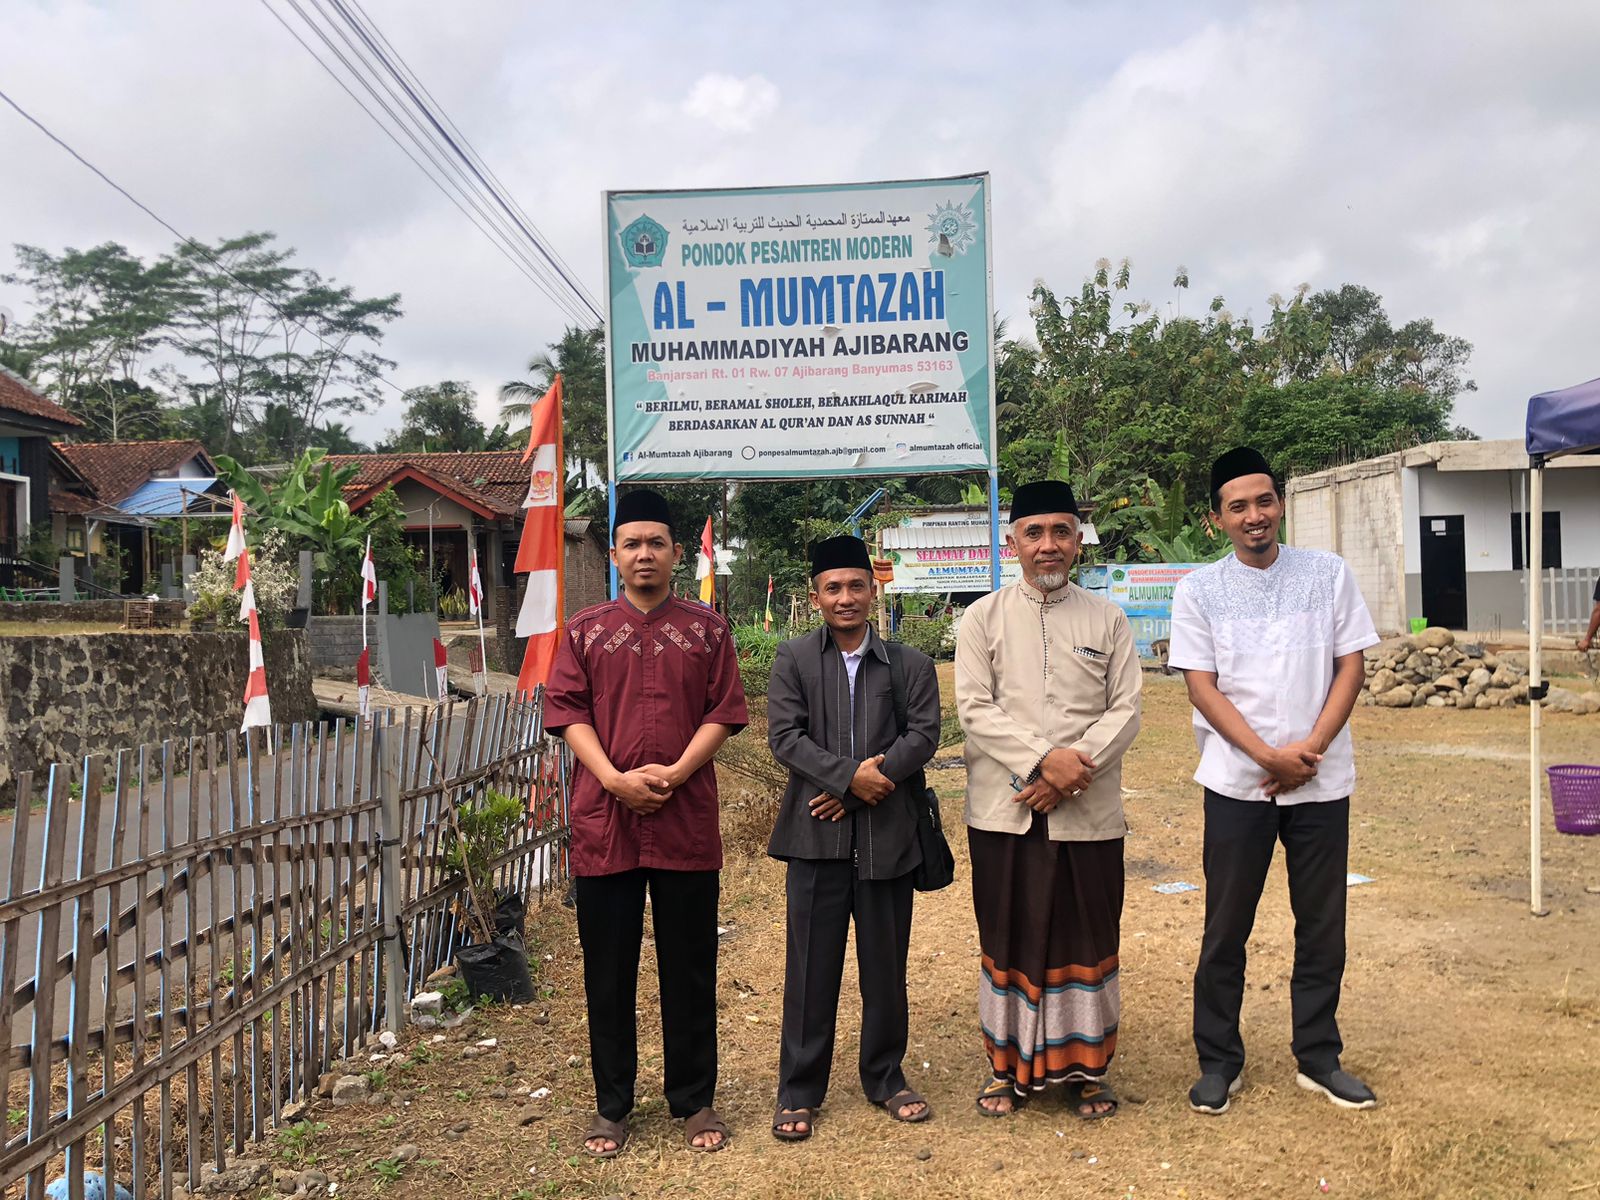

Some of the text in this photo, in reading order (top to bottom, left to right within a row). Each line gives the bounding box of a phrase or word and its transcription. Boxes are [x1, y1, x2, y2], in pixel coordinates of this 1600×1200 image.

[733, 217, 765, 234] للتربية
[806, 213, 847, 231] المحمدية
[681, 235, 913, 267] PONDOK PESANTREN MODERN
[654, 280, 695, 330] AL
[740, 270, 945, 328] MUMTAZAH
[632, 331, 968, 363] MUHAMMADIYAH AJIBARANG
[648, 360, 953, 383] Banjarsari Rt. 01 Rw. 07 Ajibarang Banyumas 53163
[645, 400, 702, 413] BERILMU,
[705, 399, 762, 410] BERAMAL
[765, 397, 815, 410] SHOLEH,
[818, 393, 907, 407] BERAKHLAQUL
[909, 392, 967, 404] KARIMAH
[669, 418, 758, 431] BERDASARKAN
[760, 418, 776, 429] AL
[779, 416, 825, 430] QUR'AN
[828, 415, 853, 427] DAN
[856, 415, 872, 426] AS
[874, 413, 925, 425] SUNNAH
[638, 449, 733, 461] Al-Mumtazah Ajibarang
[909, 442, 983, 452] almumtazah official
[1129, 585, 1176, 600] ALMUMTAZ
